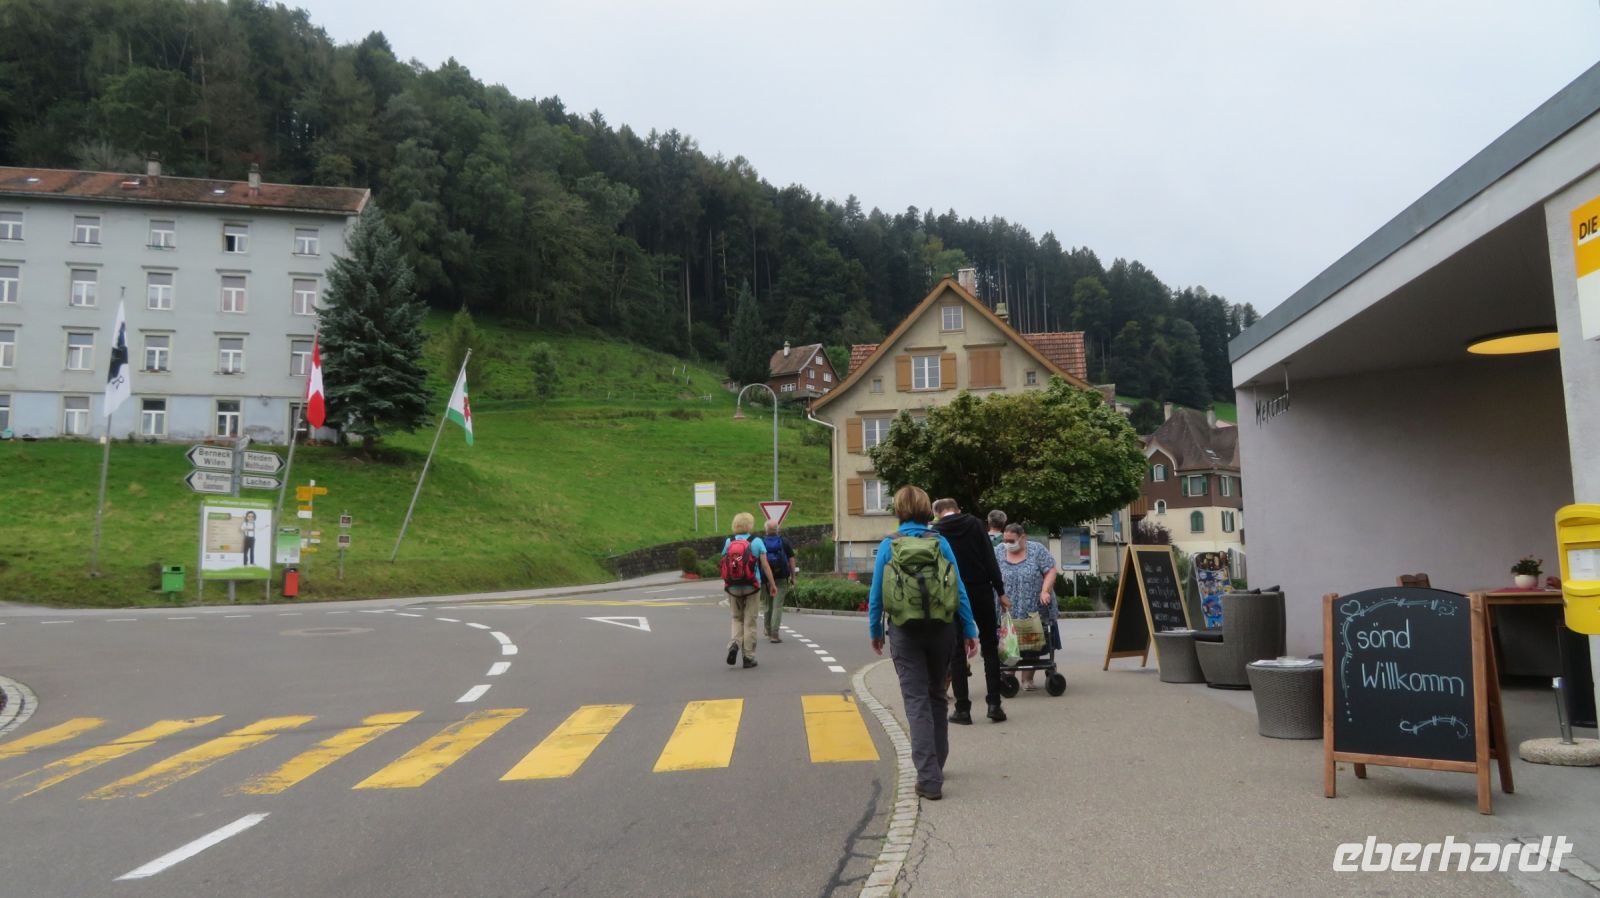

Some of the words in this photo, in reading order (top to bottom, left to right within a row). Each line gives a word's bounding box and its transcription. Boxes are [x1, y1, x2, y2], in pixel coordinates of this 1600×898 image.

[1579, 215, 1598, 240] DIE
[198, 446, 231, 458] Berneck
[247, 453, 273, 462] Heiden
[203, 457, 226, 466] Wilen
[246, 477, 271, 486] Lachen
[1356, 619, 1410, 649] sönd
[1361, 661, 1464, 696] Willkomm
